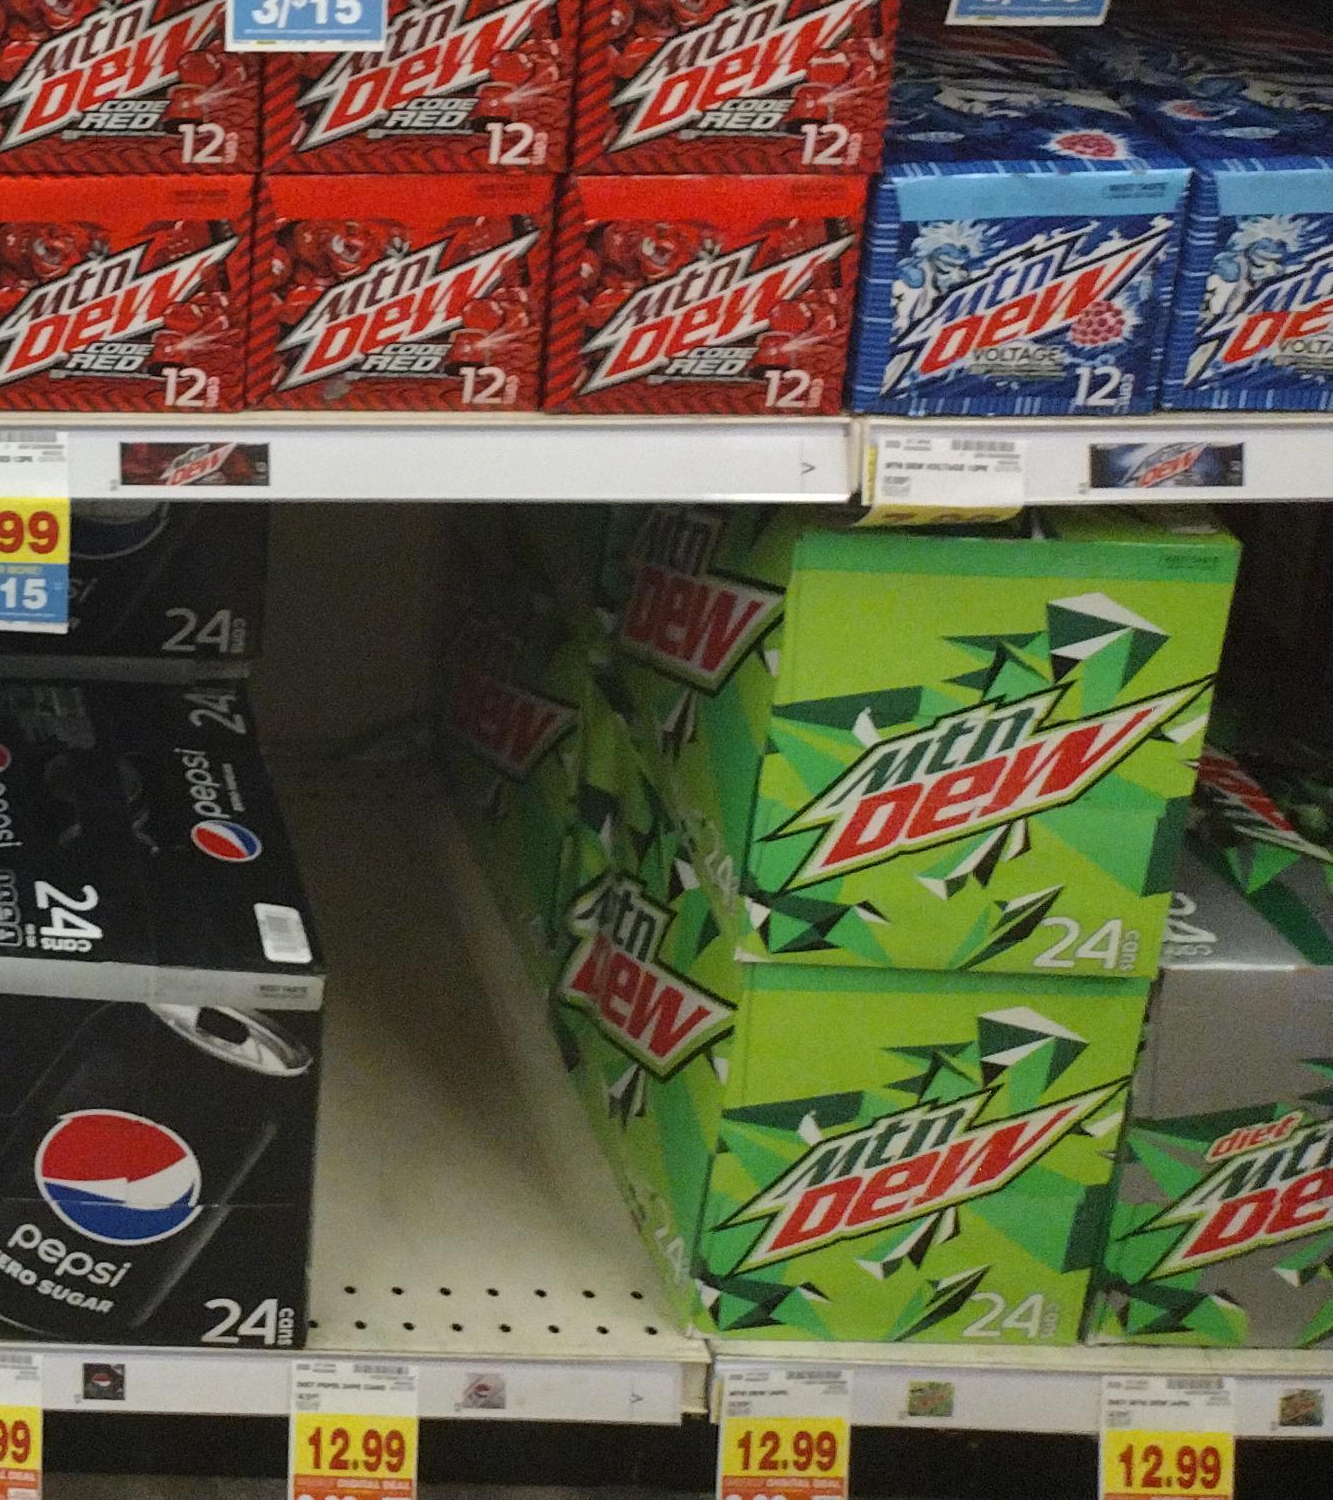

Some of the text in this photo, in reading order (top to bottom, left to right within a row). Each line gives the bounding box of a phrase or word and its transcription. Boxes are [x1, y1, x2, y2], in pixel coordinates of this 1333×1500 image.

[699, 111, 780, 130] RED
[721, 99, 794, 113] CODE
[802, 125, 847, 164] 12
[65, 353, 146, 371] RED
[88, 341, 154, 355] CODE
[971, 345, 1060, 363] VOLTAGE
[162, 368, 208, 407] 12
[1075, 367, 1120, 406] 12
[33, 880, 103, 940] 24
[1034, 916, 1124, 969] 24
[1212, 1113, 1297, 1160] diet
[8, 1222, 132, 1290] pepsi
[34, 1277, 114, 1313] SUGAR
[202, 1298, 279, 1345] 24
[308, 1427, 405, 1472] 12.99
[738, 1431, 837, 1471] 12.99
[1119, 1444, 1221, 1489] 12.99
